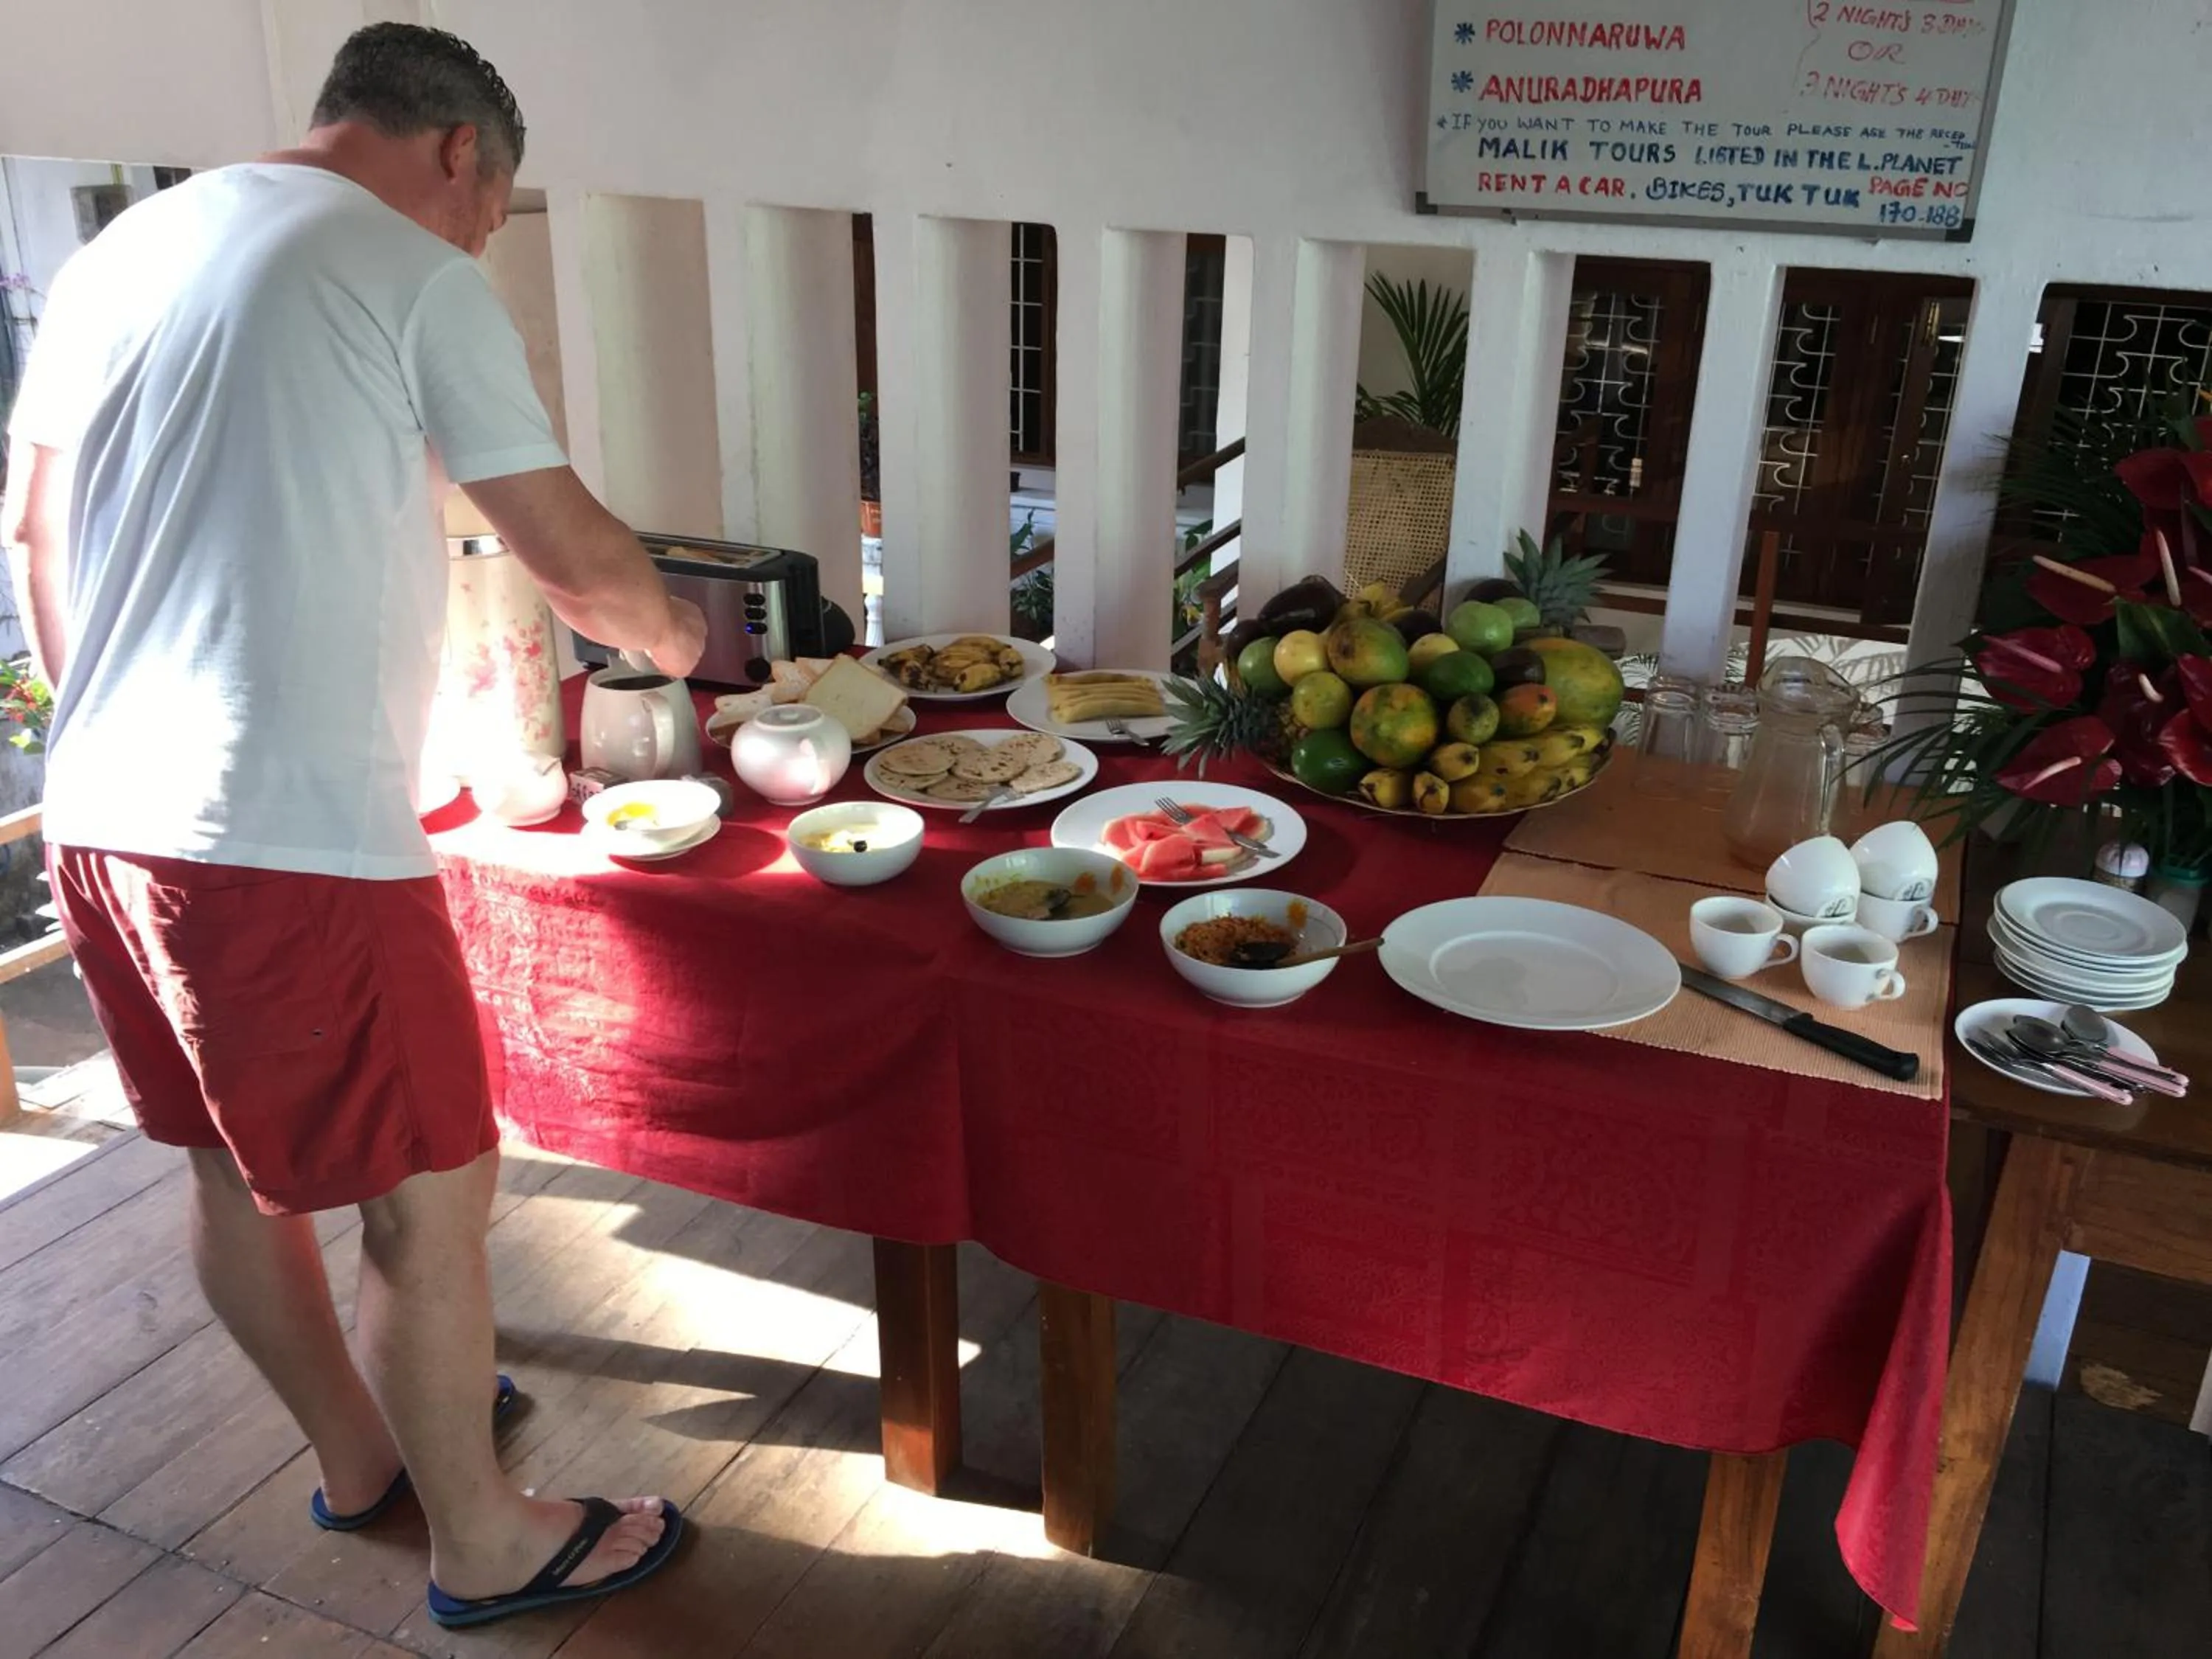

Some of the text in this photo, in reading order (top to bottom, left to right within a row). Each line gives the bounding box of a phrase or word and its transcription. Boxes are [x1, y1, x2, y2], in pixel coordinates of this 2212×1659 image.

[1813, 1, 1829, 22] 2
[1486, 18, 1686, 50] POLONNARUWA
[1848, 41, 1905, 65] OR
[1478, 74, 1702, 104] ANURADHAPURA
[1915, 88, 1932, 105] 4
[1517, 117, 1575, 131] WANT
[1587, 119, 1610, 133] TO
[1621, 120, 1667, 136] MAKE
[1682, 121, 1718, 136] THE
[1733, 123, 1771, 136] TOUR
[1787, 123, 1852, 138] PLEASE
[1896, 128, 1924, 139] THE
[1478, 137, 1569, 161] MALIK
[1589, 140, 1676, 164] TOURS
[1694, 145, 1764, 166] LISTED
[1774, 148, 1797, 167] IN
[1806, 150, 1851, 170] THE
[1478, 173, 1547, 193] RENT
[1554, 175, 1571, 195] A
[1801, 184, 1860, 209] TUK
[1868, 176, 1970, 199] PAGE NO
